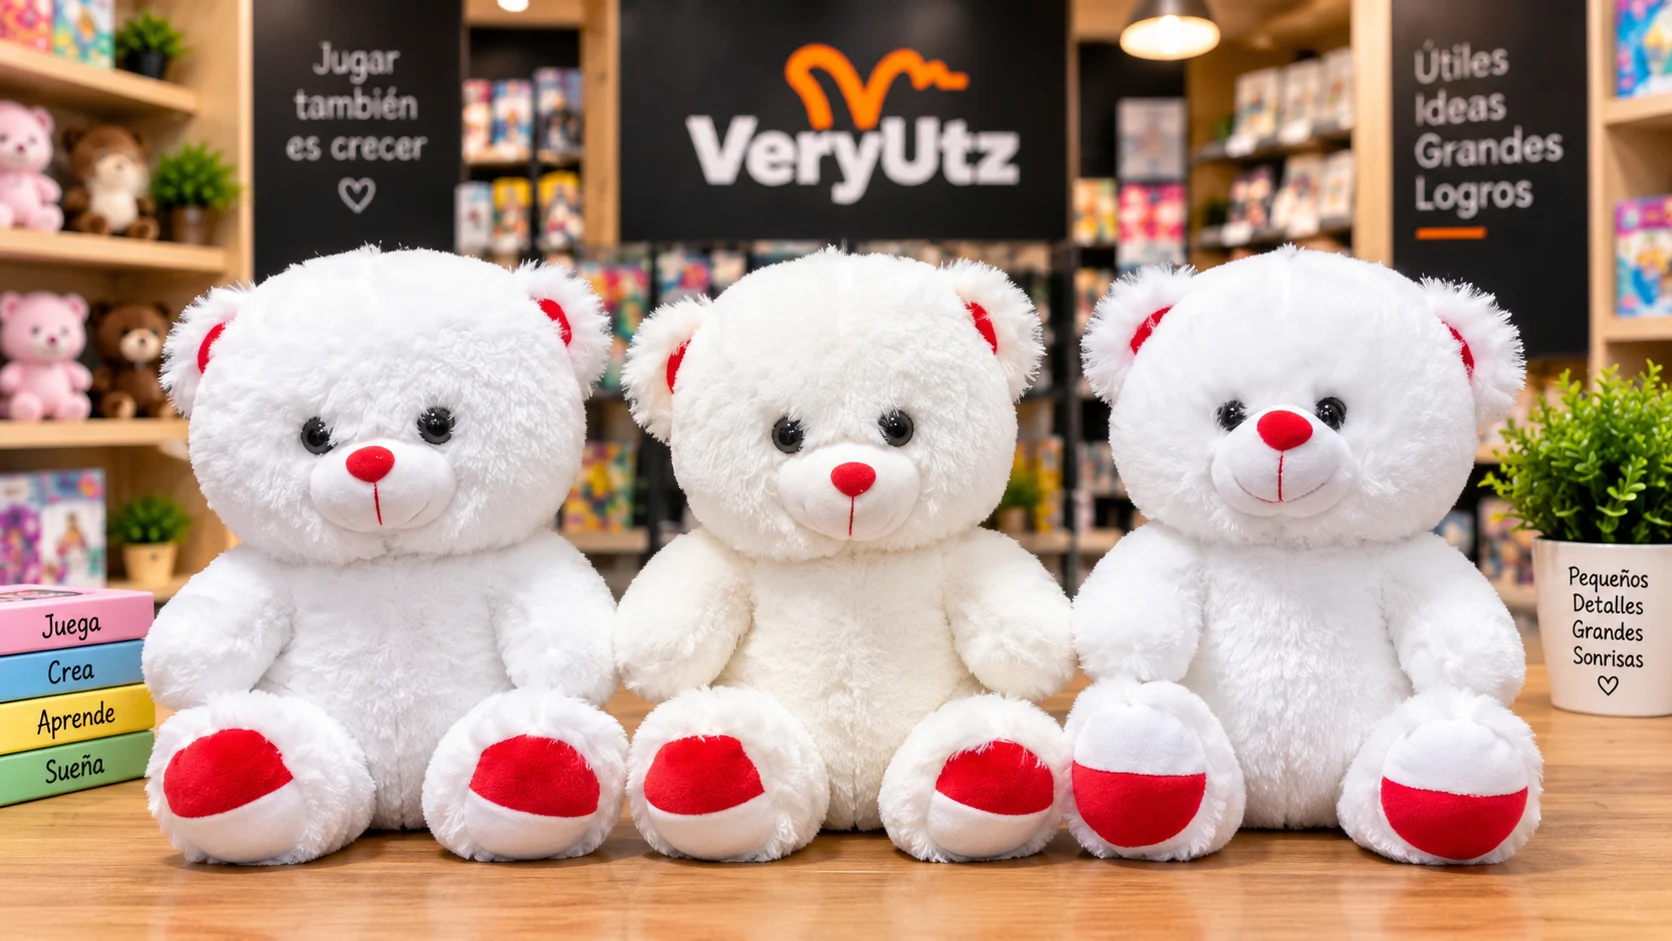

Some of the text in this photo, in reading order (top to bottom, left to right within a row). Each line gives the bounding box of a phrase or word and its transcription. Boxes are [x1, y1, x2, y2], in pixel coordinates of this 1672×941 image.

[313, 41, 399, 83] Jugar
[1414, 39, 1509, 84] Útiles
[294, 87, 417, 120] también
[1416, 89, 1506, 125] Ideas
[286, 136, 427, 160] es crecer
[687, 116, 1018, 204] VeryUtz
[1415, 124, 1563, 168] Grandes
[1415, 175, 1533, 219] Logros
[1569, 566, 1648, 592] Pequeños
[1573, 593, 1643, 615] Detalles
[42, 614, 101, 641] Juega
[1573, 620, 1643, 641] Grandes
[48, 660, 94, 684] Crea
[1574, 646, 1643, 668] Sonrisas
[37, 701, 115, 739] Aprende
[45, 754, 105, 784] Sueña
